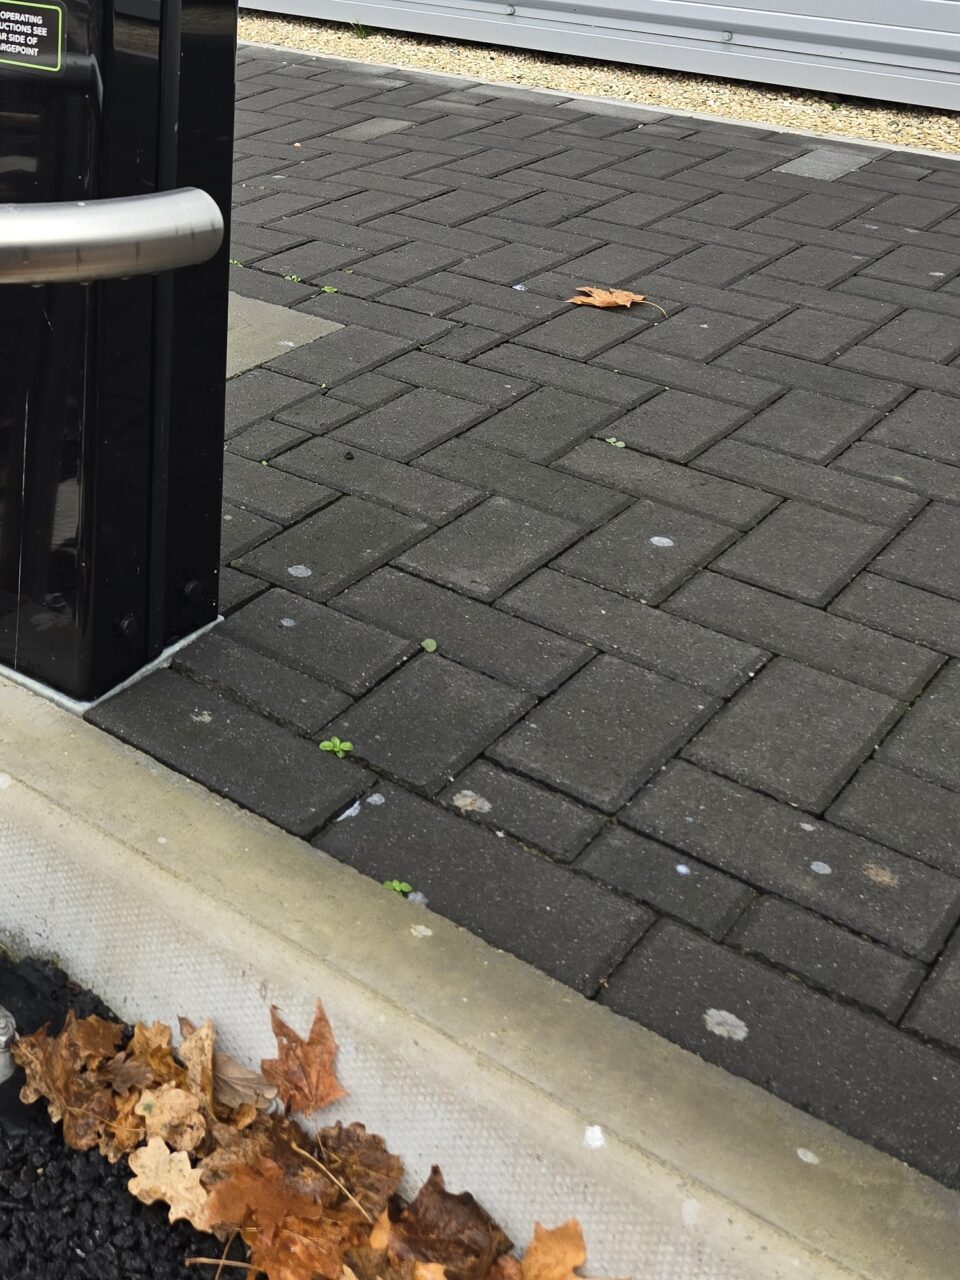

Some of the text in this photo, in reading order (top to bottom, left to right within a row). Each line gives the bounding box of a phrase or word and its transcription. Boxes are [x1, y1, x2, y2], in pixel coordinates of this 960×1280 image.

[0, 11, 43, 24] OPERATING
[32, 26, 47, 36] SEE
[8, 33, 25, 43] SIDE
[26, 36, 38, 45] OF
